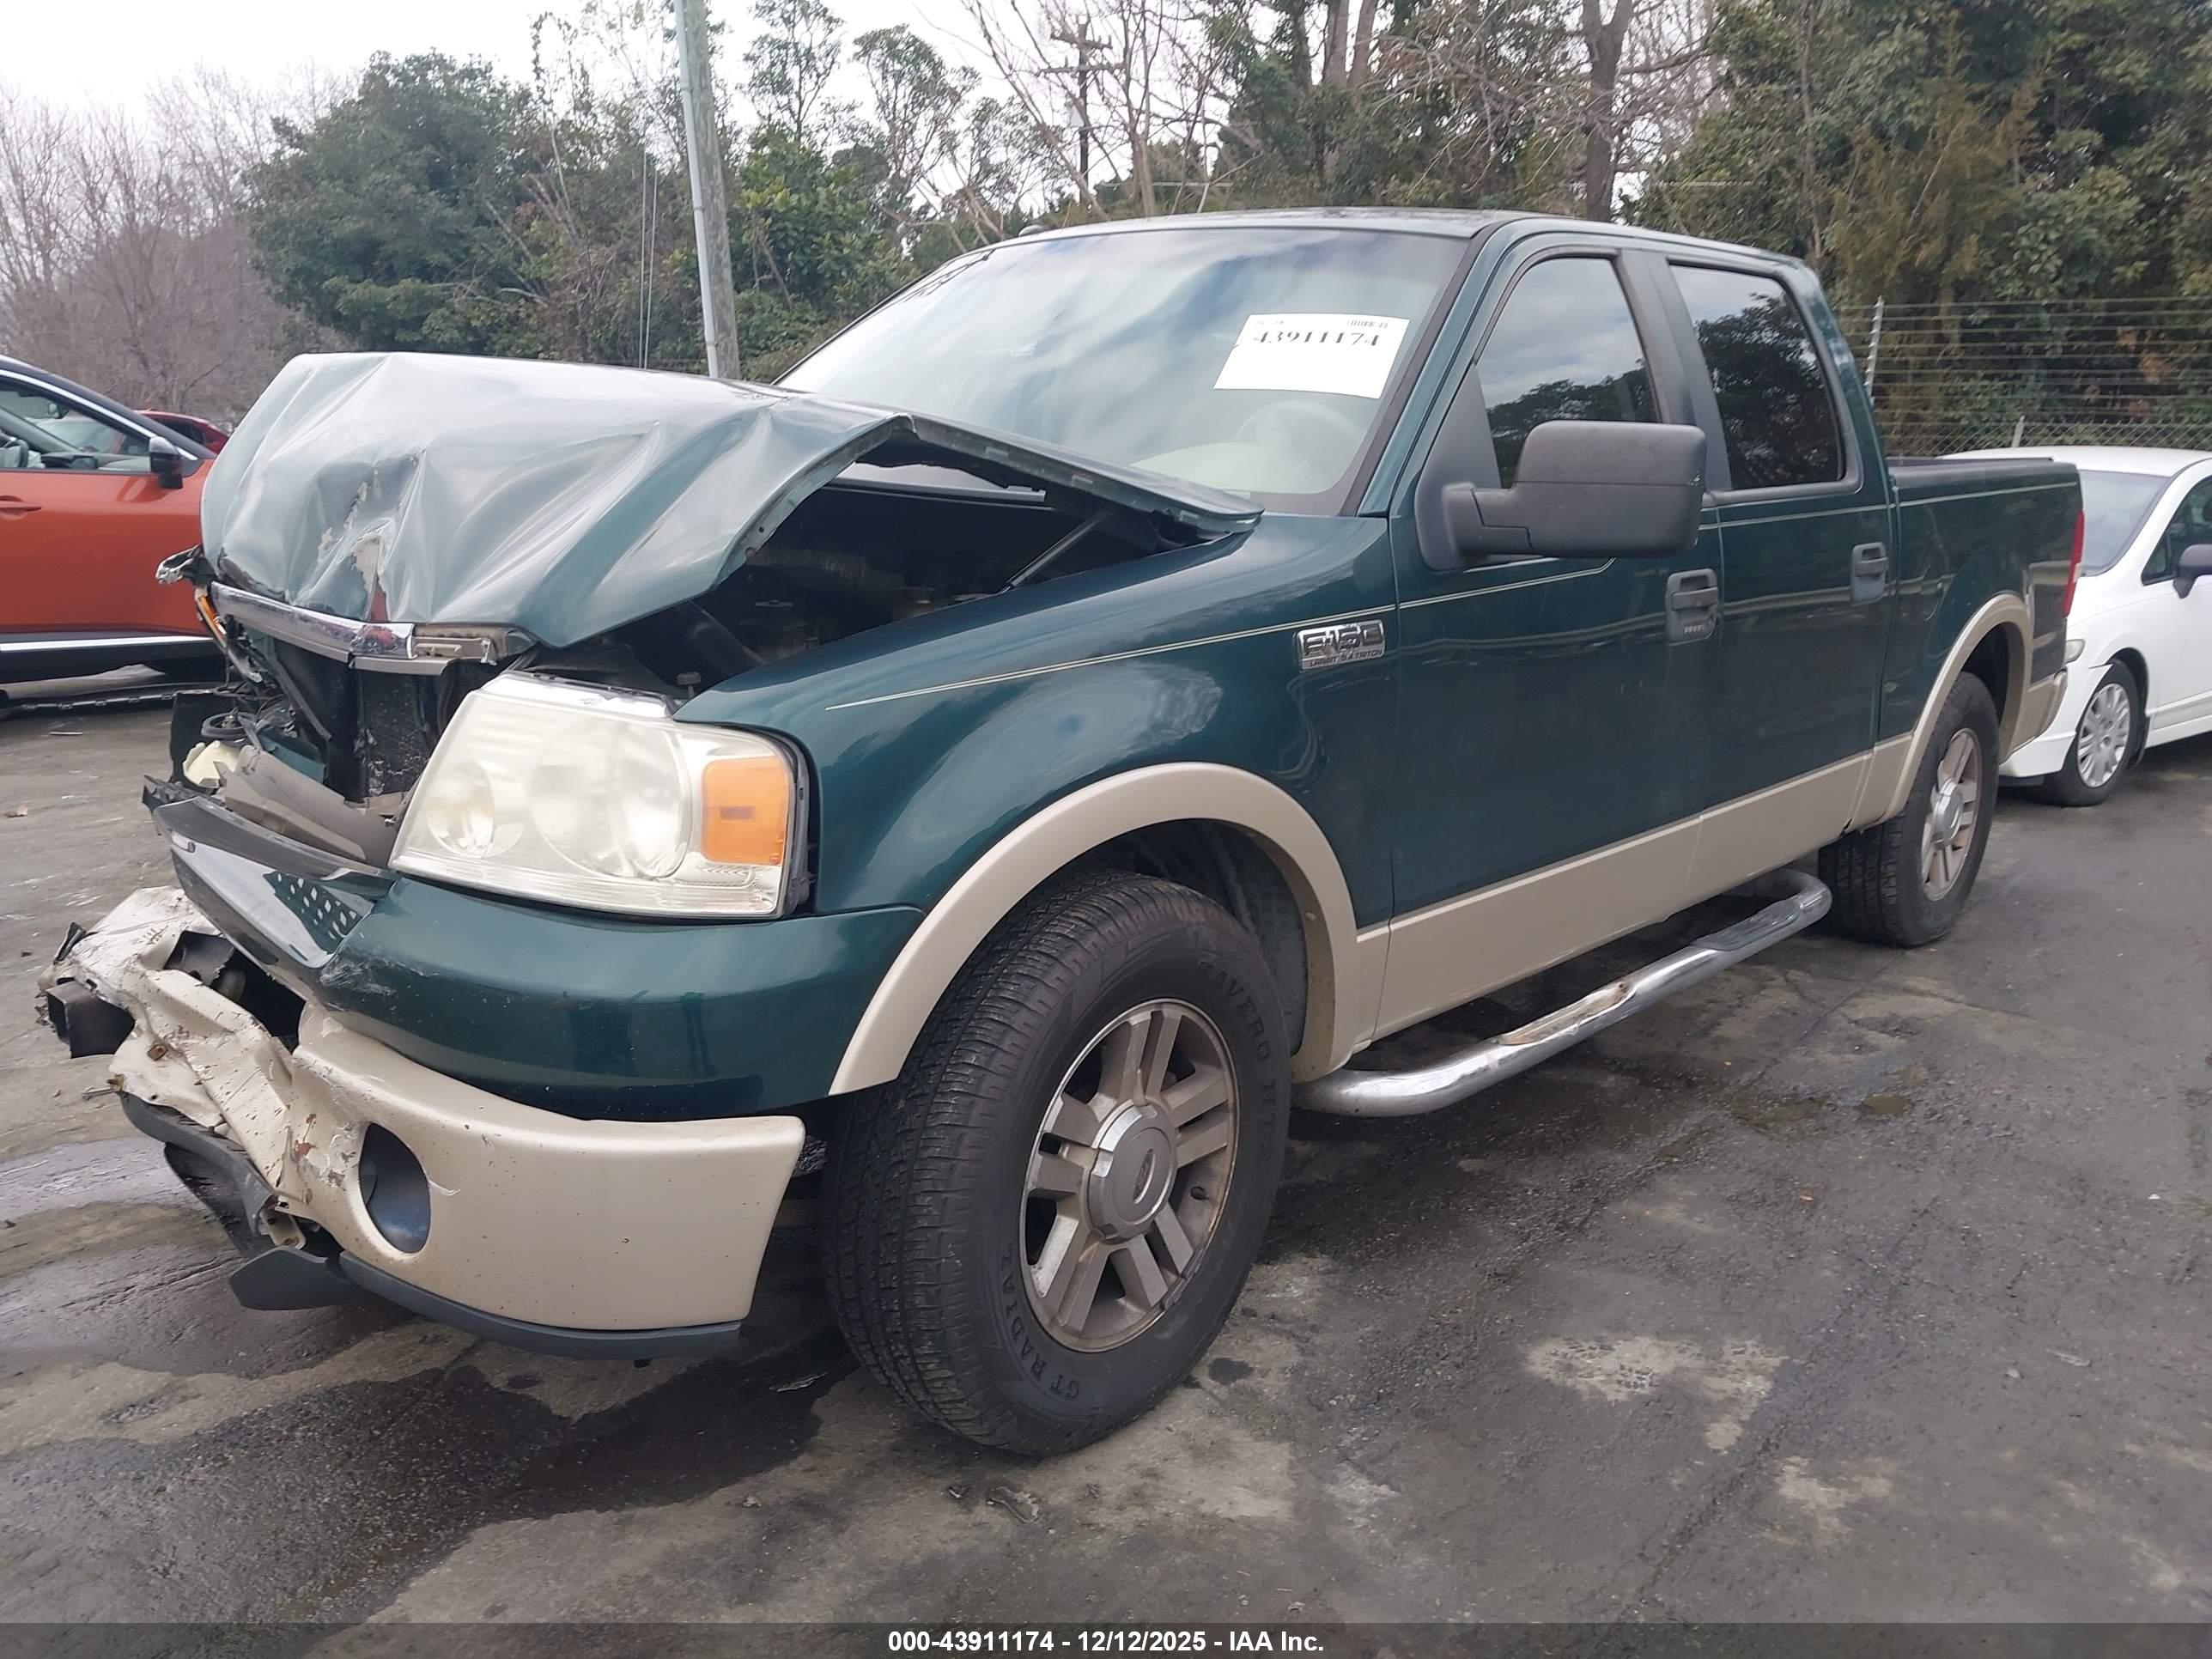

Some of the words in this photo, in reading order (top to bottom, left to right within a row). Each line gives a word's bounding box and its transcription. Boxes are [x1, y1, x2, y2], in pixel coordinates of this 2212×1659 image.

[1254, 330, 1379, 347] 43911174
[1000, 1243, 1048, 1382] RADIAL
[1049, 1374, 1080, 1400] GT
